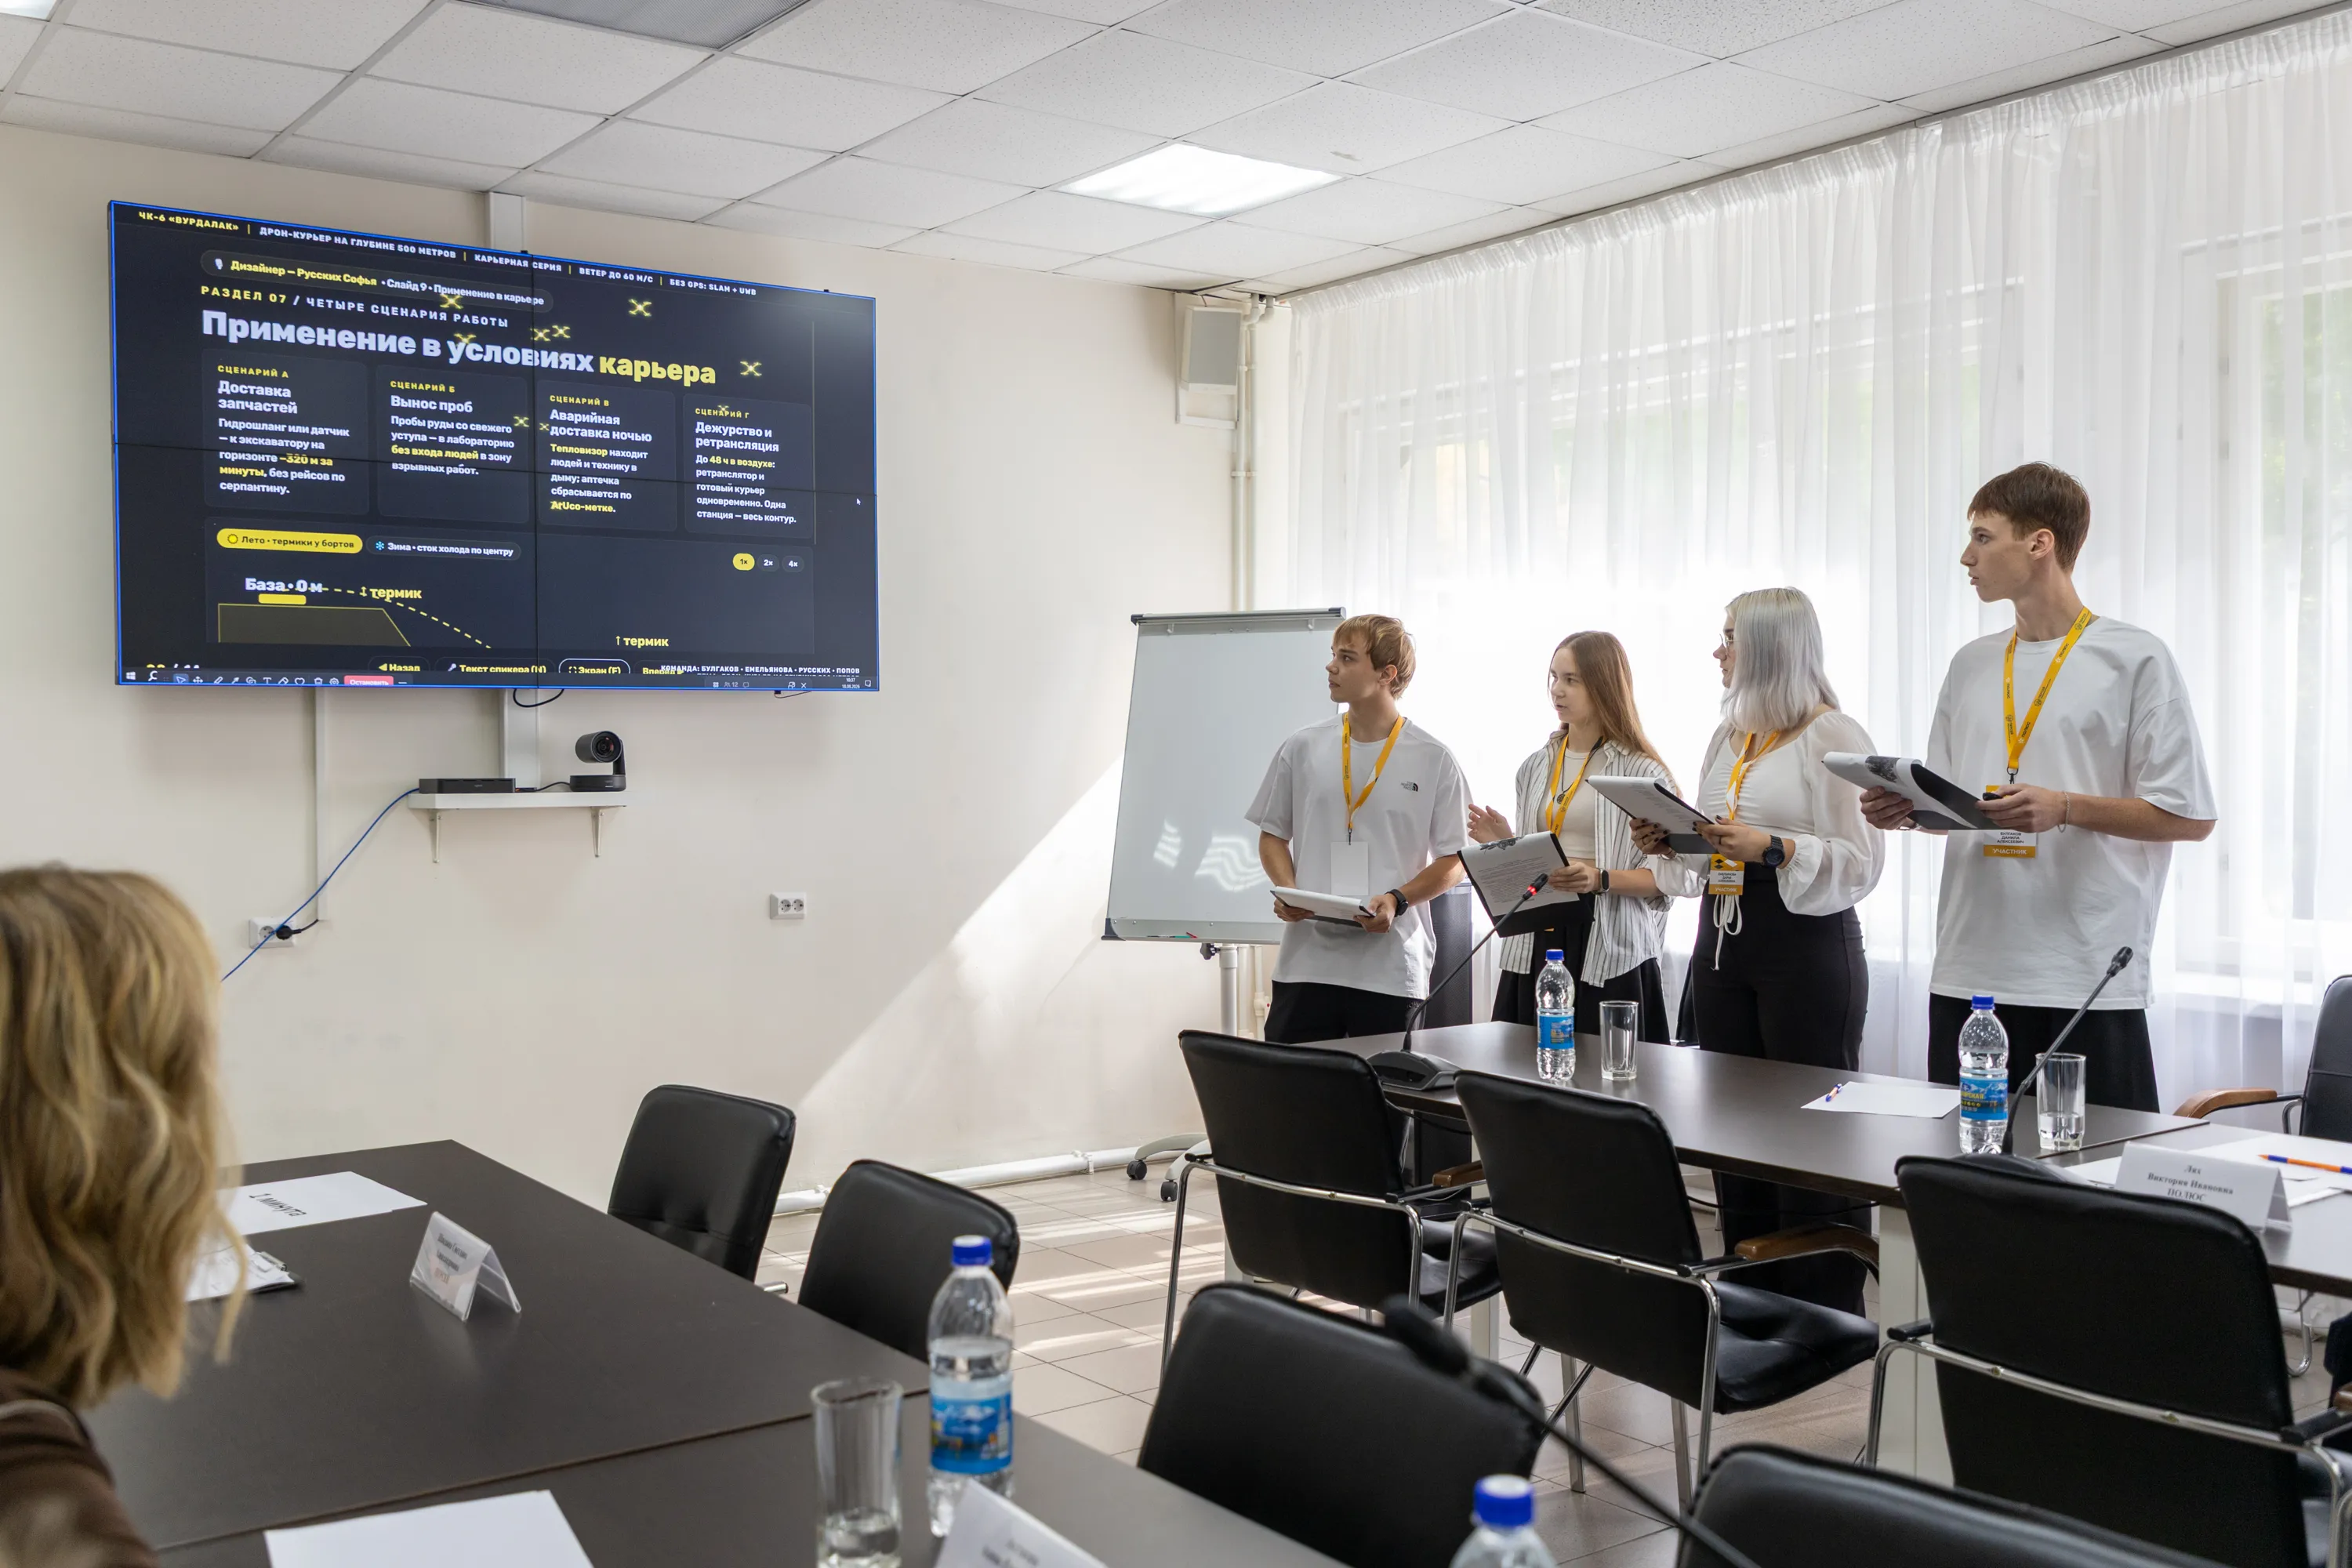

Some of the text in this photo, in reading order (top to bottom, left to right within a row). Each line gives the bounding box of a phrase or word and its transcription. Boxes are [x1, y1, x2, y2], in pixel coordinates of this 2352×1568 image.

[139, 211, 239, 231] ЧК-6 «ВУРДАЛАК»
[260, 226, 456, 258] ДРОН-КУРЬЕР НА ГЛУБИНЕ 500 МЕТРОВ
[474, 253, 562, 272] КАРЬЕРНАЯ СЕРИЯ
[230, 260, 377, 287] Дизайнер Русских Софья
[579, 267, 607, 278] ВЕТЕР
[608, 271, 622, 280] ДО
[636, 274, 654, 283] М/С
[387, 278, 427, 292] Слайд 9
[670, 278, 757, 296] БЕЗ GPS: SLAM UWB
[201, 285, 287, 303] РАЗДЕЛ 07
[434, 284, 495, 300] Применение
[503, 294, 545, 307] карьере
[307, 297, 509, 328] ЧЕТЫРЕ СЦЕНАРИЯ РАБОТЫ
[201, 309, 716, 387] Применение в условиях карьера
[217, 365, 278, 377] СЦЕНАРИЙ
[217, 379, 292, 398] Доставка
[390, 380, 445, 392] СЦЕНАРИЙ
[218, 398, 298, 414] запчастей
[390, 394, 473, 414] Вынос проб
[550, 394, 601, 406] СЦЕНАРИЙ
[550, 408, 621, 426] Аварийная
[695, 408, 742, 419] СЦЕНАРИЙ
[218, 418, 350, 437] Гидрошланг или датчик
[390, 416, 426, 427] Пробы
[427, 419, 455, 430] руды
[470, 423, 513, 434] свежего
[695, 421, 772, 437] Дежурство и
[391, 431, 427, 442] уступа
[446, 435, 515, 448] лабораторию
[550, 426, 652, 442] доставка ночью
[238, 436, 310, 450] экскаватору
[310, 441, 325, 450] на
[695, 437, 779, 452] ретрансляция
[219, 451, 278, 463] горизонте
[391, 445, 411, 456] без
[412, 447, 443, 458] входа
[445, 450, 479, 460] людей
[488, 454, 512, 463] зону
[550, 443, 648, 459] Тепловизор находит
[392, 463, 479, 475] взрывных работ.
[550, 458, 583, 468] людей
[591, 462, 630, 473] технику
[695, 455, 708, 464] До
[709, 456, 722, 464] 48
[737, 459, 775, 469] воздухе:
[219, 466, 346, 482] минуты, без рейсов по
[550, 474, 619, 485] дыму; аптечка
[695, 469, 757, 481] ретранслятор
[219, 481, 290, 495] серпантину.
[550, 486, 619, 499] сбрасывается
[696, 483, 765, 496] готовый курьер
[696, 497, 786, 509] одновременно. Одна
[696, 510, 797, 524] станция весь контур.
[241, 535, 265, 544] Лето
[272, 539, 312, 547] термики
[322, 539, 354, 549] бортов
[387, 542, 412, 551] Зима
[438, 546, 470, 554] холода
[483, 548, 514, 557] центру
[245, 577, 285, 592] База
[310, 583, 323, 593] м
[369, 588, 423, 601] термик
[622, 637, 669, 648] термик
[459, 664, 488, 673] Текст
